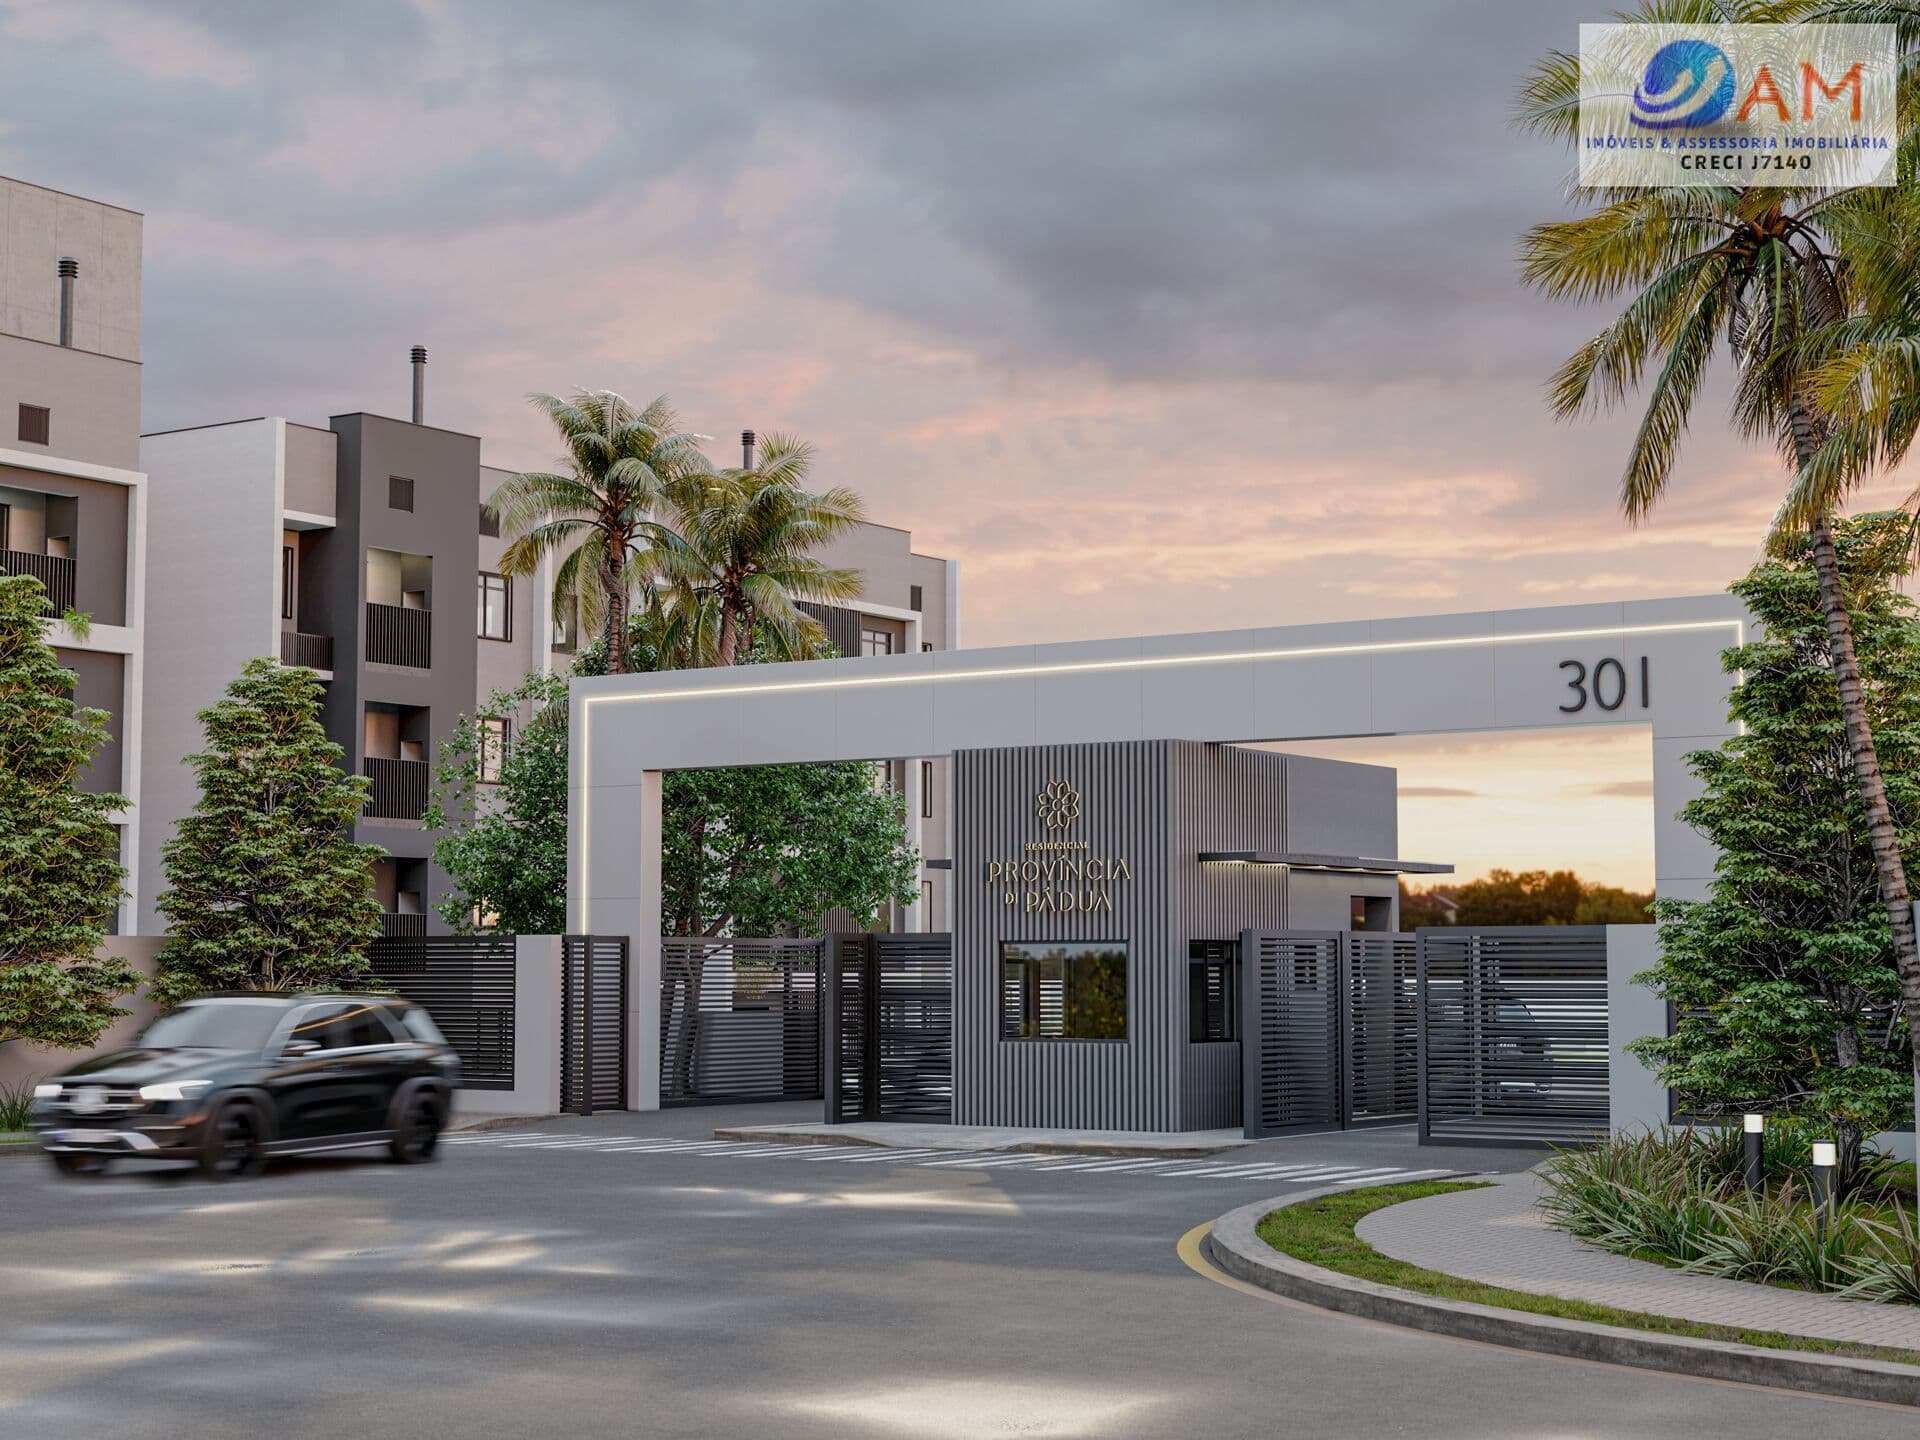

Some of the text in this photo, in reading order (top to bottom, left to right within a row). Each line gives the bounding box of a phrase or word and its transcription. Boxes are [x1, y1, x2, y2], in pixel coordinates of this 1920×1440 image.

[1559, 656, 1649, 713] 301
[1024, 841, 1090, 851] RESIDENCIAL
[988, 855, 1132, 883] PROVÍNCIA
[1005, 886, 1113, 913] DI PÁDUA
